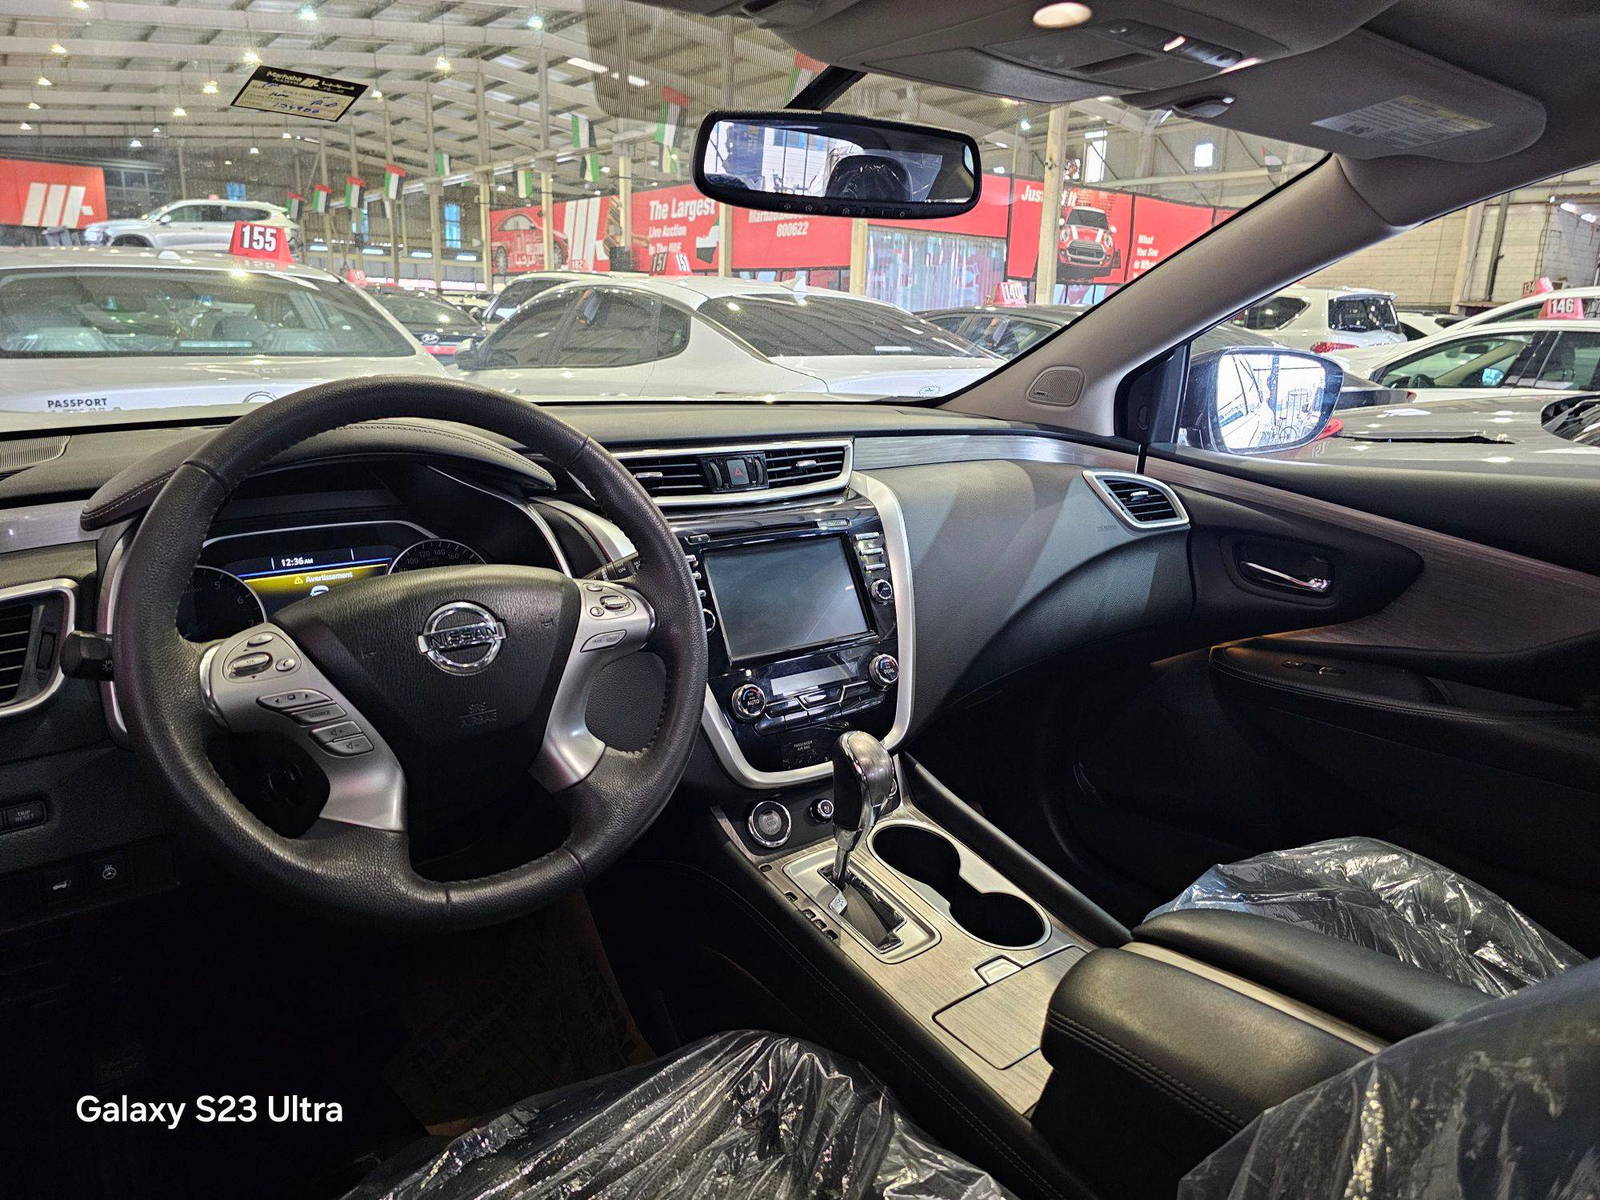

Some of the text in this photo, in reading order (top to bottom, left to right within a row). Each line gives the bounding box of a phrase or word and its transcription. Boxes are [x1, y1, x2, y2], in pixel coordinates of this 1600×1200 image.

[1021, 185, 1044, 203] Jus
[649, 197, 716, 221] The Largest
[242, 225, 277, 252] 155
[648, 224, 688, 239] Live Auction
[652, 253, 668, 272] 151
[675, 253, 691, 272] 151
[1551, 299, 1575, 314] 146
[47, 398, 108, 409] PASSPORT
[305, 571, 353, 583] Avertissement
[431, 625, 498, 650] NISSAN
[747, 698, 760, 706] AUTO
